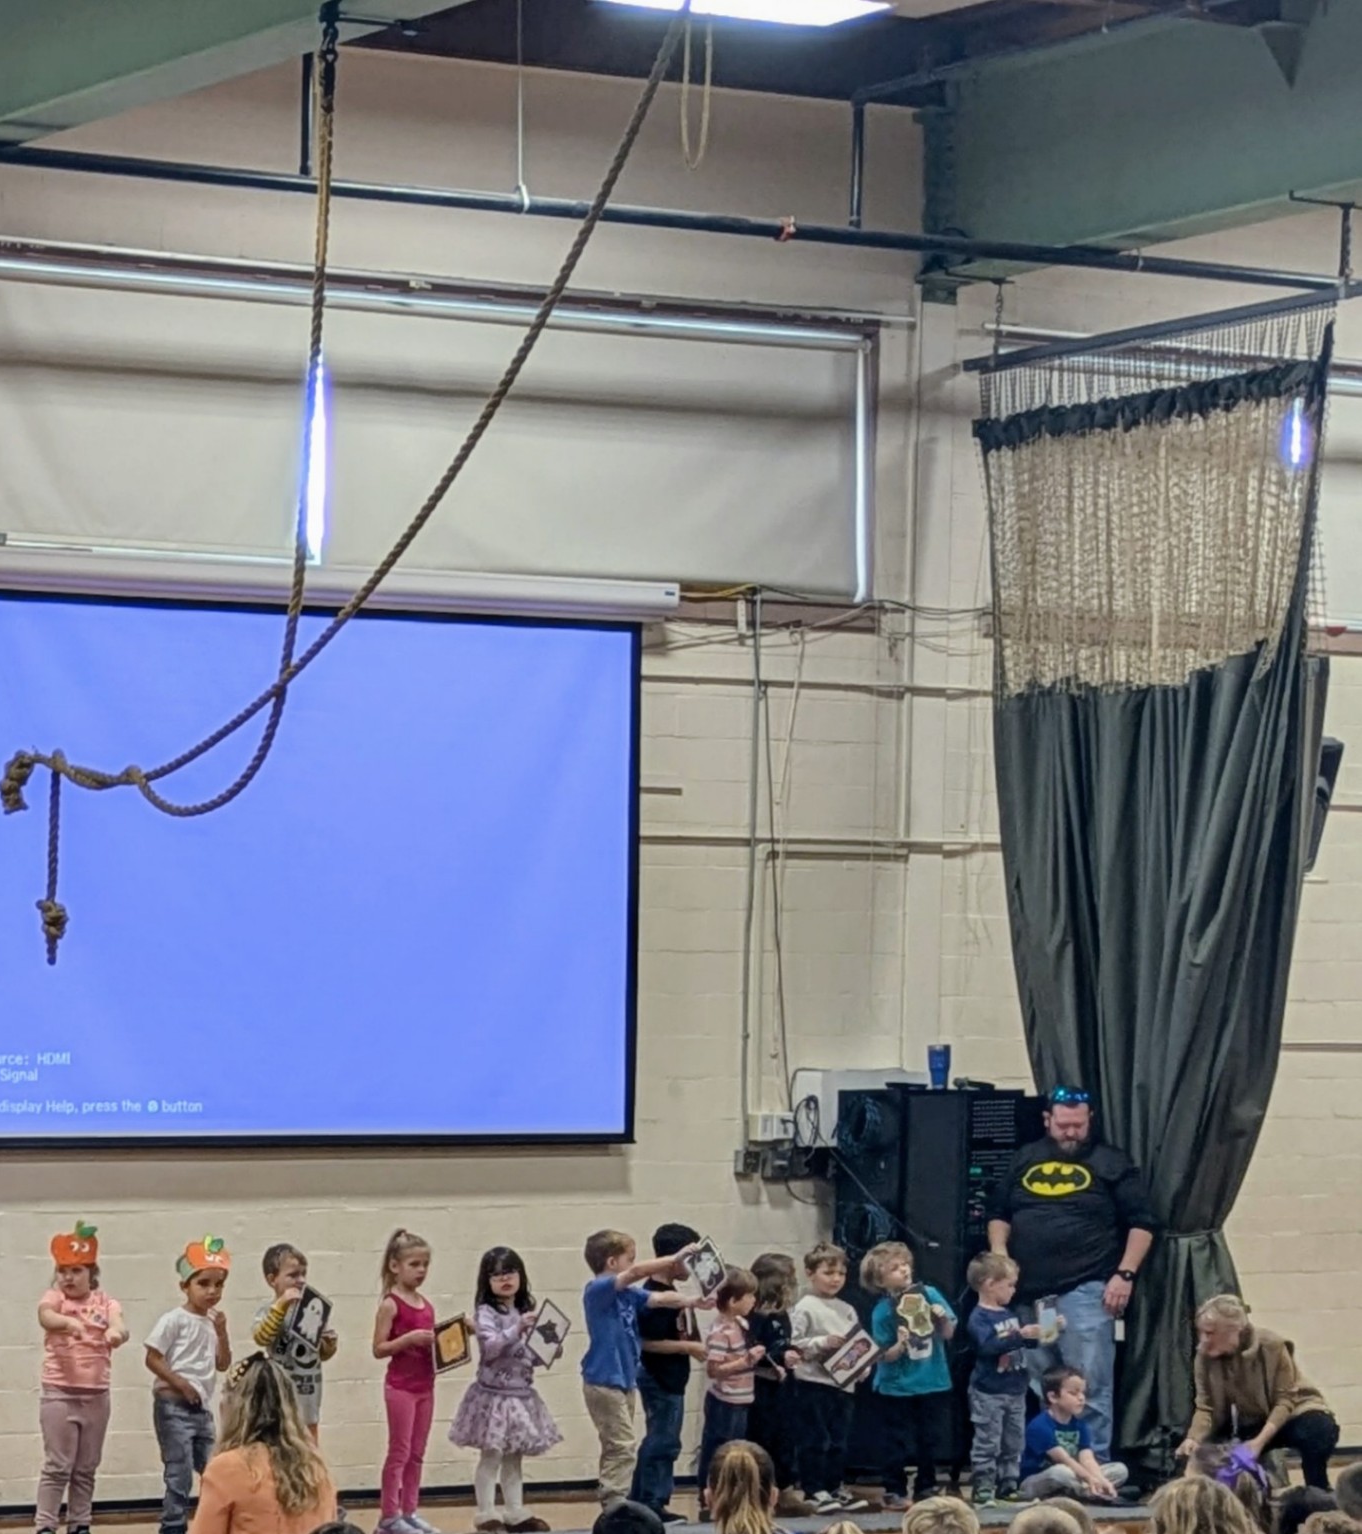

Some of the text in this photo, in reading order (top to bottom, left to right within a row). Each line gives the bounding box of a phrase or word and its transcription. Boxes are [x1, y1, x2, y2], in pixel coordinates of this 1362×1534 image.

[37, 1051, 71, 1065] HDMI
[0, 1068, 38, 1083] Signal
[46, 1101, 78, 1114] Help,
[82, 1102, 117, 1114] press
[122, 1101, 141, 1112] the
[162, 1101, 202, 1113] button
